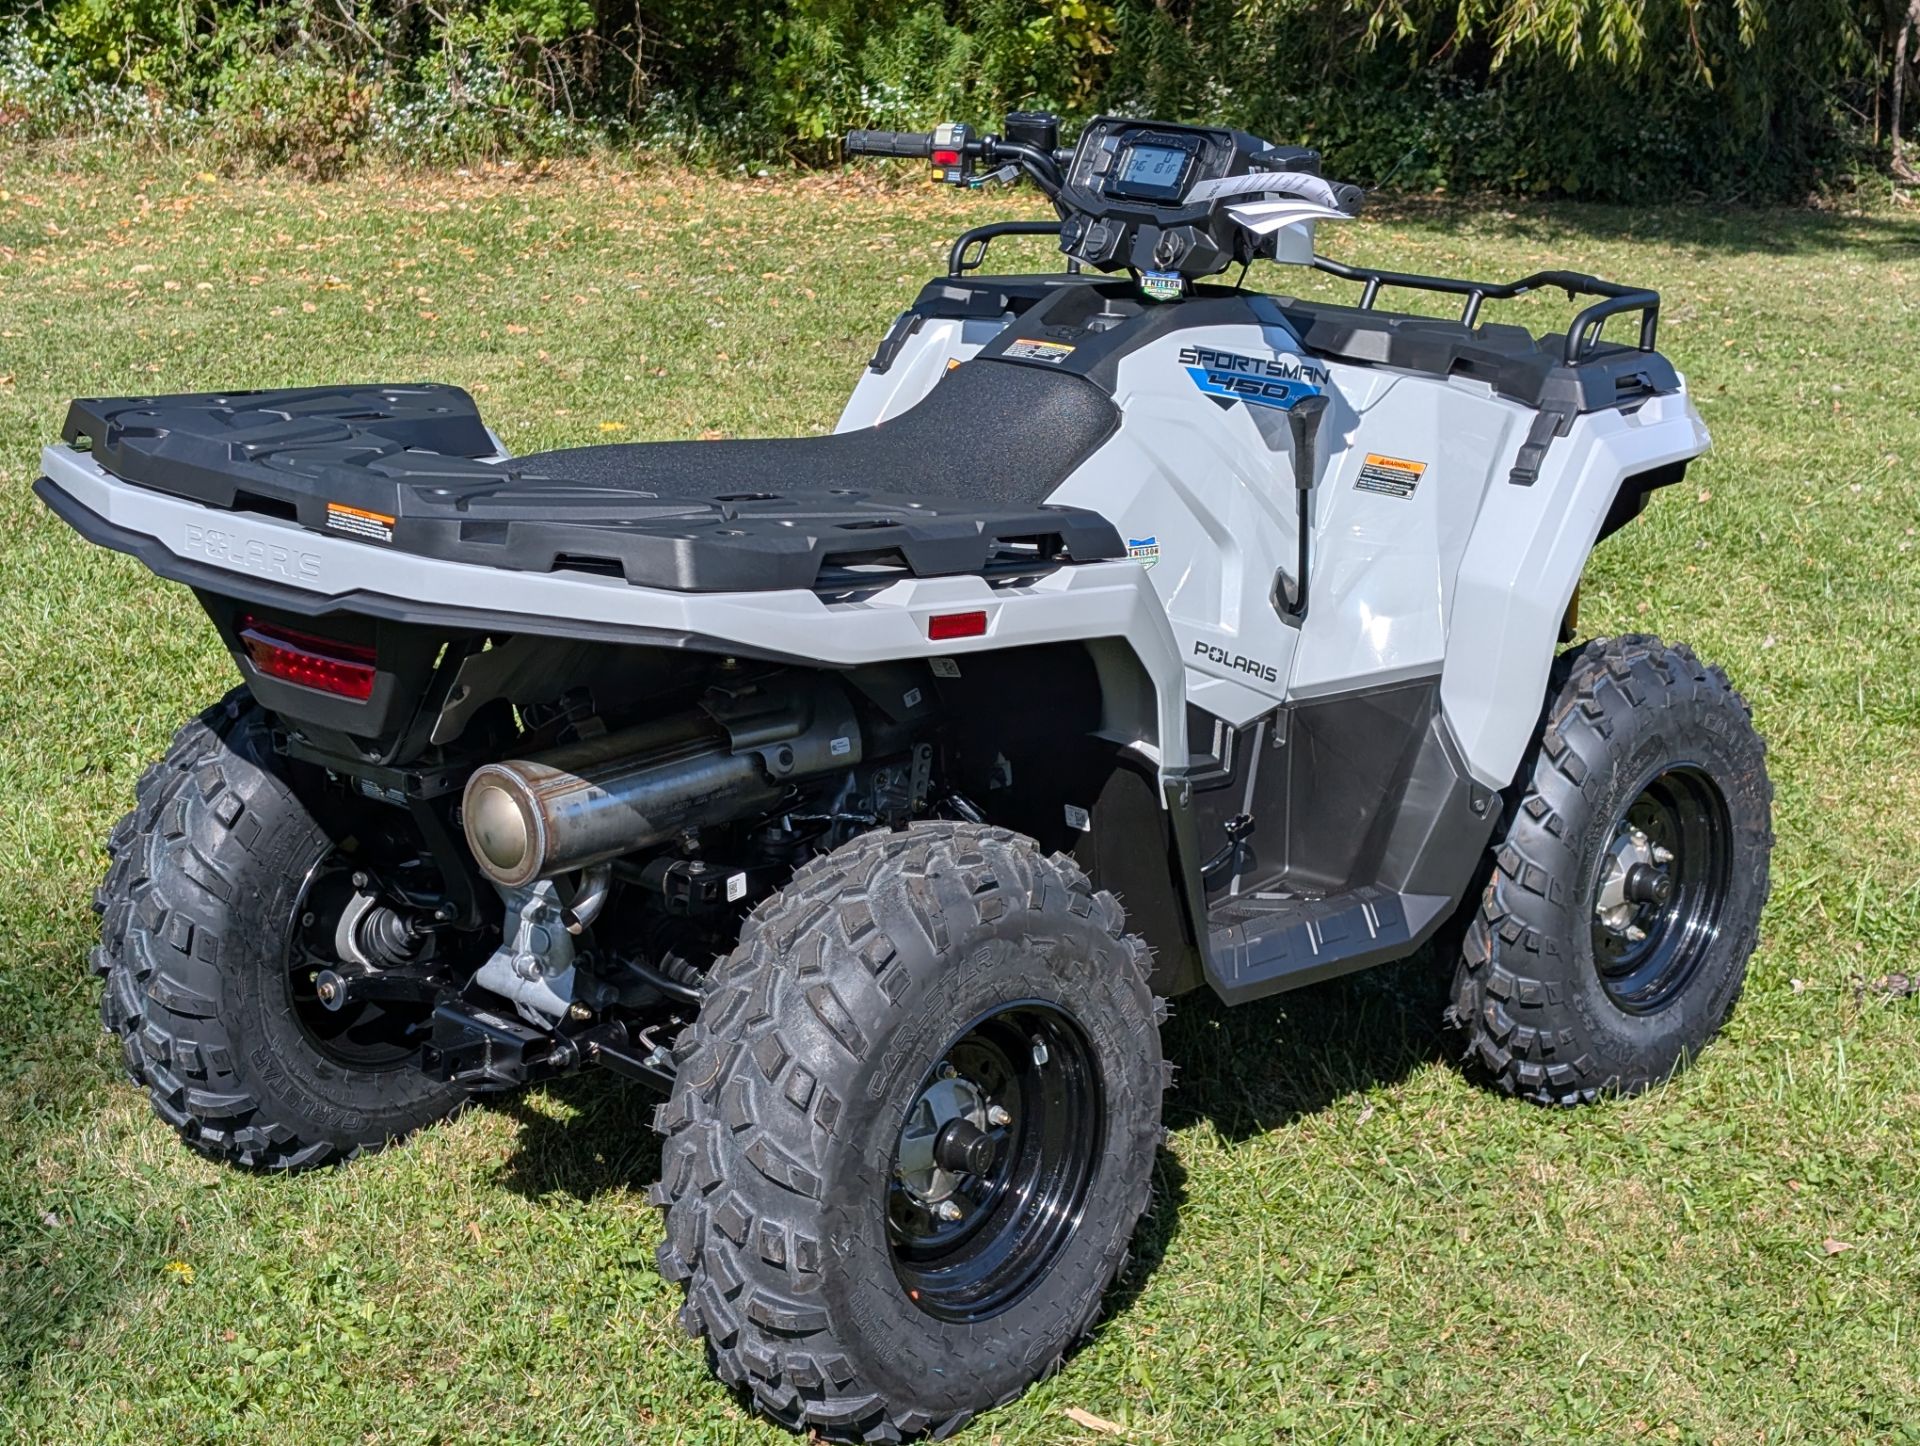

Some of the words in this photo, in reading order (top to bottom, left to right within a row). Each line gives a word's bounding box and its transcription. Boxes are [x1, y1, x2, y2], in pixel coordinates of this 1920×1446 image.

[1178, 349, 1331, 384] SPORTSMAN
[1207, 373, 1290, 399] 450
[184, 523, 322, 583] POLARIS
[1134, 547, 1159, 557] NELSON
[1193, 640, 1278, 683] POLARIS
[867, 946, 993, 1098] CARLSTAR
[250, 1044, 361, 1130] CARLSTAR
